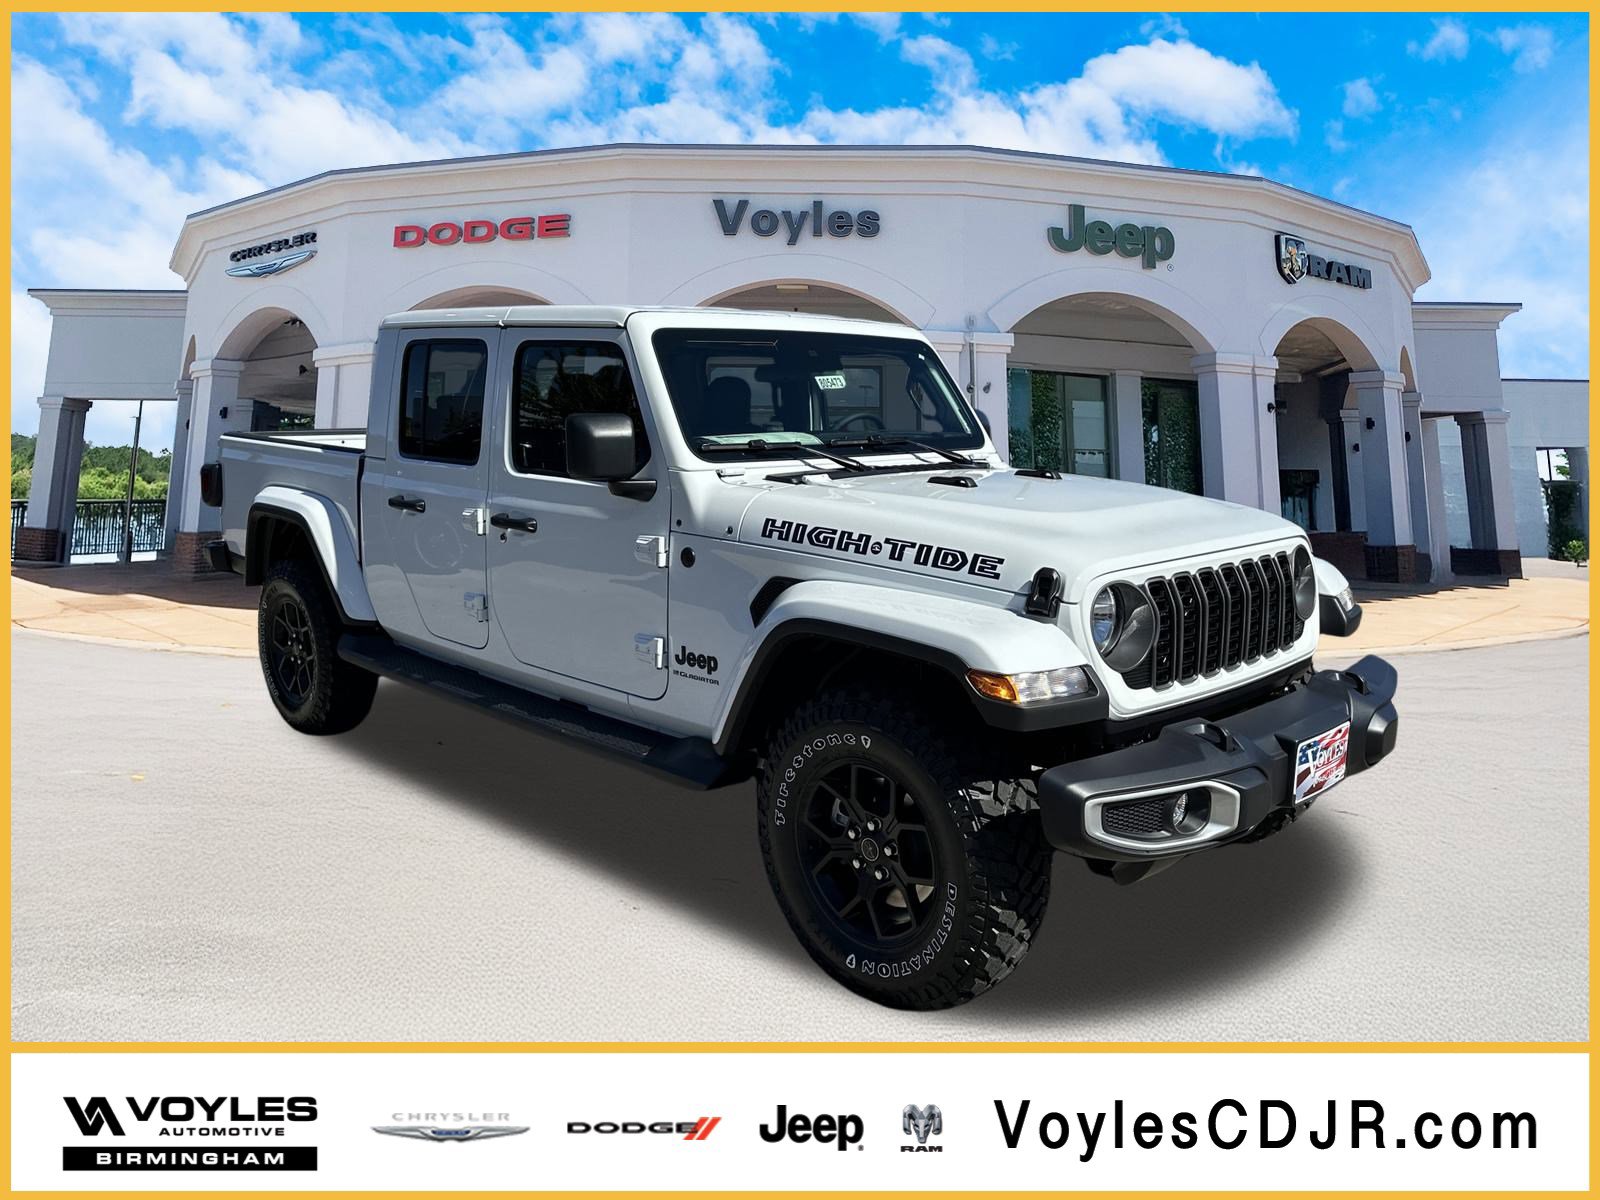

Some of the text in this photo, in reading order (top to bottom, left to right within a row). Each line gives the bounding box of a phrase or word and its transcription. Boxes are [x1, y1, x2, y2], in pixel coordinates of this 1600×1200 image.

[393, 213, 571, 248] DODGE
[712, 199, 881, 246] Voyles
[1047, 204, 1175, 269] Jeep
[229, 231, 318, 263] CHRYSLER
[1307, 253, 1372, 290] RAM
[761, 517, 1006, 580] HIGH TIDE
[675, 645, 719, 675] Jeep
[679, 671, 720, 686] GLADIATOR
[774, 732, 857, 826] Firestone
[861, 882, 958, 978] DESTINATION
